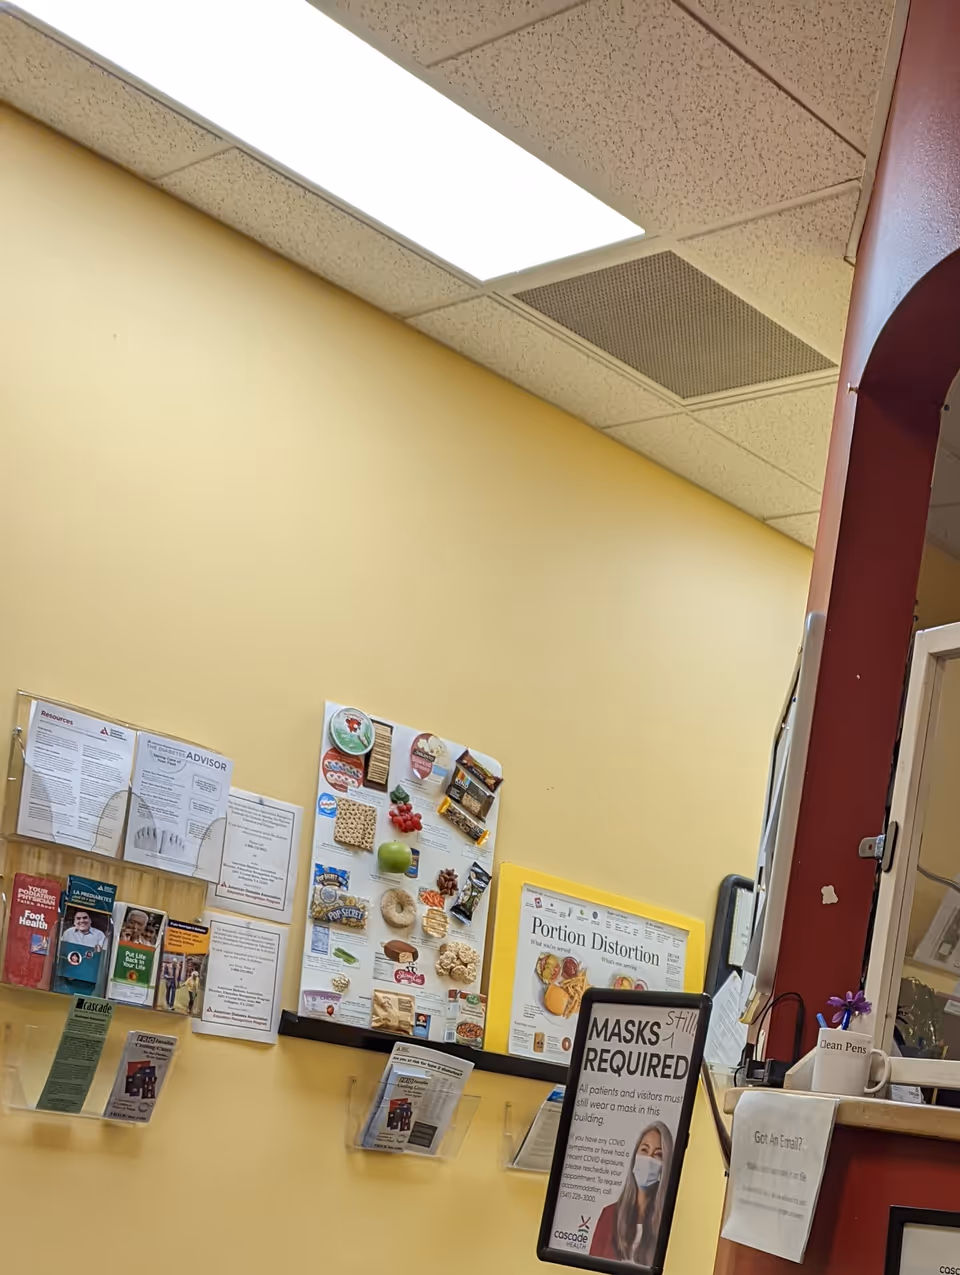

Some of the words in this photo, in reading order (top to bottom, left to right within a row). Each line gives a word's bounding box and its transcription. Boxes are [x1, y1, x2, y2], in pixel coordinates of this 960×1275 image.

[41, 711, 73, 725] Resources
[186, 752, 227, 771] ADVISOR
[28, 885, 48, 894] YOUR
[19, 916, 48, 929] Health
[25, 910, 45, 921] Foot
[531, 916, 586, 947] Portion
[591, 932, 660, 966] Distortion
[83, 1001, 112, 1014] cascade
[588, 1017, 661, 1046] MASKS
[820, 1040, 842, 1050] Clean
[845, 1042, 866, 1054] Pens
[584, 1048, 689, 1080] REQUIRED
[579, 1084, 588, 1092] All
[589, 1085, 619, 1096] patients
[620, 1089, 635, 1098] and
[637, 1090, 662, 1102] visitors
[576, 1099, 589, 1107] still
[590, 1101, 609, 1109] wear
[617, 1104, 636, 1113] mask
[638, 1105, 645, 1114] in
[647, 1106, 660, 1116] this
[574, 1112, 604, 1126] building.
[755, 1131, 768, 1144] Got
[770, 1133, 778, 1145] An
[780, 1135, 802, 1150] Email?
[554, 1230, 588, 1243] cascade
